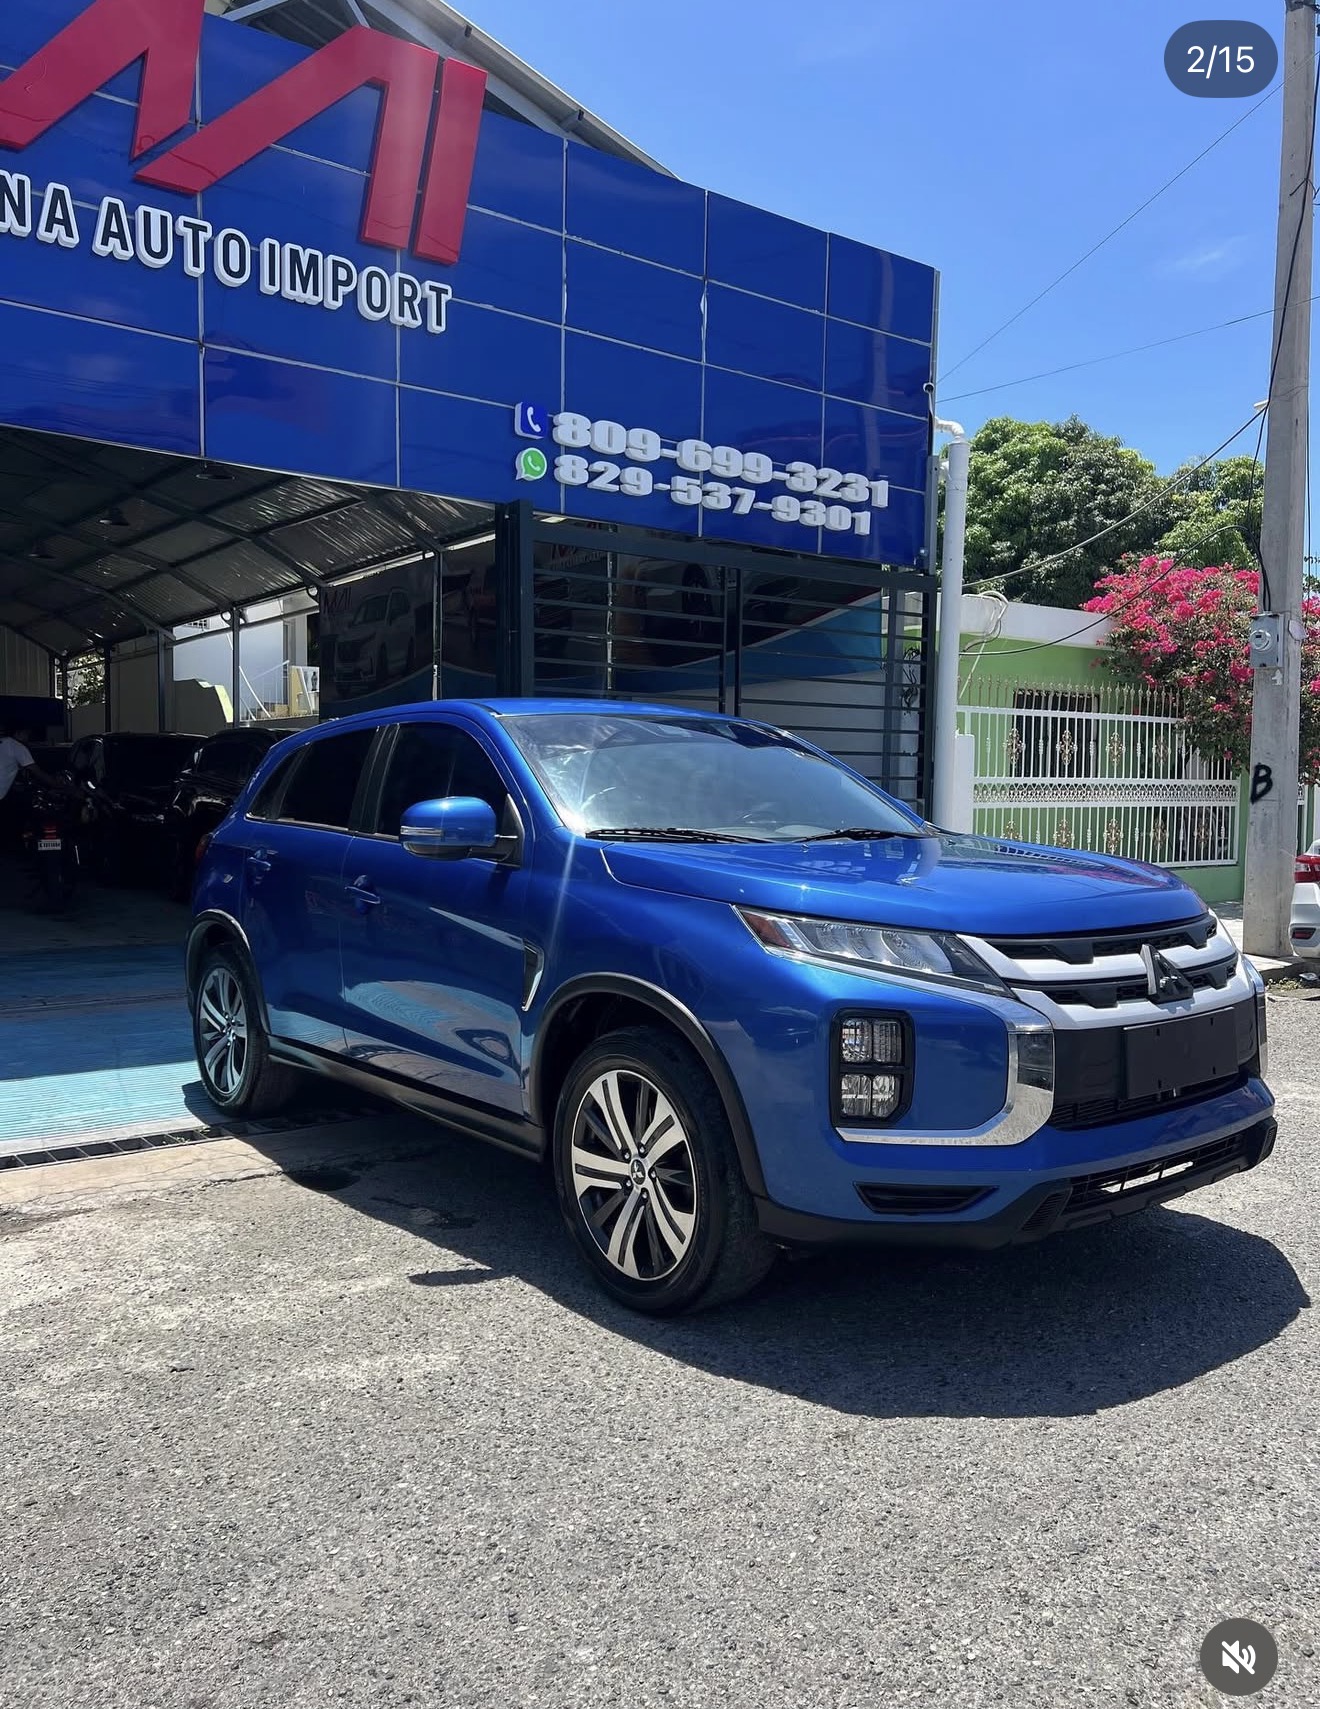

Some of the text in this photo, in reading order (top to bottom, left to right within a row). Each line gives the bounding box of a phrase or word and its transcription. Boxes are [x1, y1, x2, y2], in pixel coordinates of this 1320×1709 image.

[92, 196, 251, 288] AUTO
[260, 238, 452, 334] IMPORT
[552, 411, 889, 508] 809-699-3231
[553, 454, 871, 536] 829-537-9301
[1250, 762, 1273, 804] B
